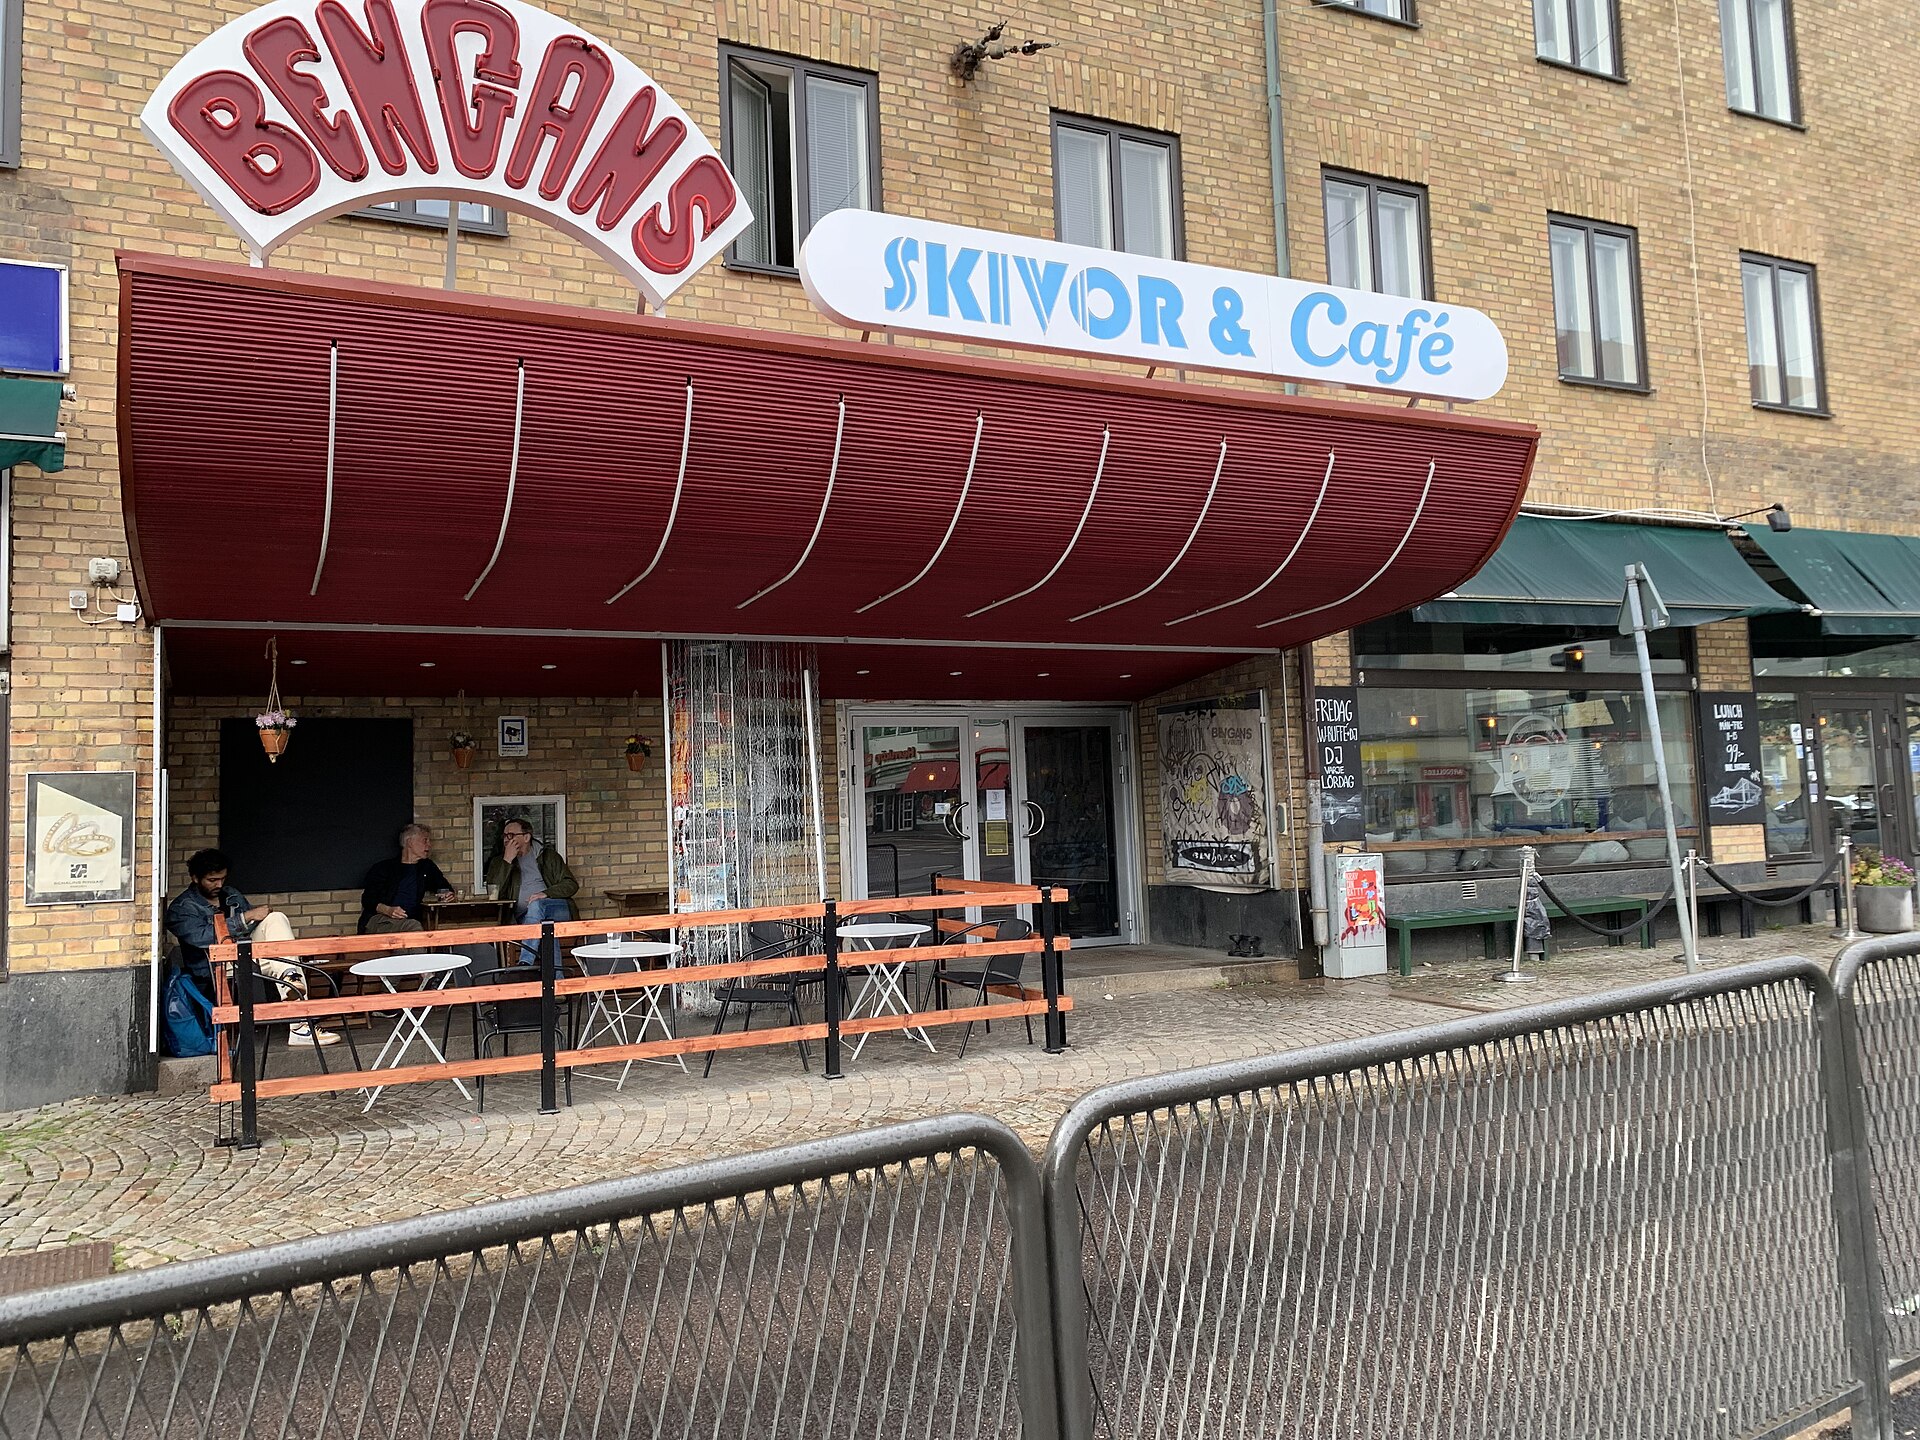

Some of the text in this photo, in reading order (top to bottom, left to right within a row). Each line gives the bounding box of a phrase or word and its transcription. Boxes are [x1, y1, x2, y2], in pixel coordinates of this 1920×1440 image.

[167, 0, 736, 275] BENGANS
[884, 236, 1455, 384] SKIVOR & Café
[1315, 699, 1353, 722] FREDAG
[1713, 704, 1743, 719] LUNCH
[1324, 746, 1343, 765] DJ
[1323, 766, 1345, 775] VARJE
[1320, 774, 1355, 789] LÖRDAG
